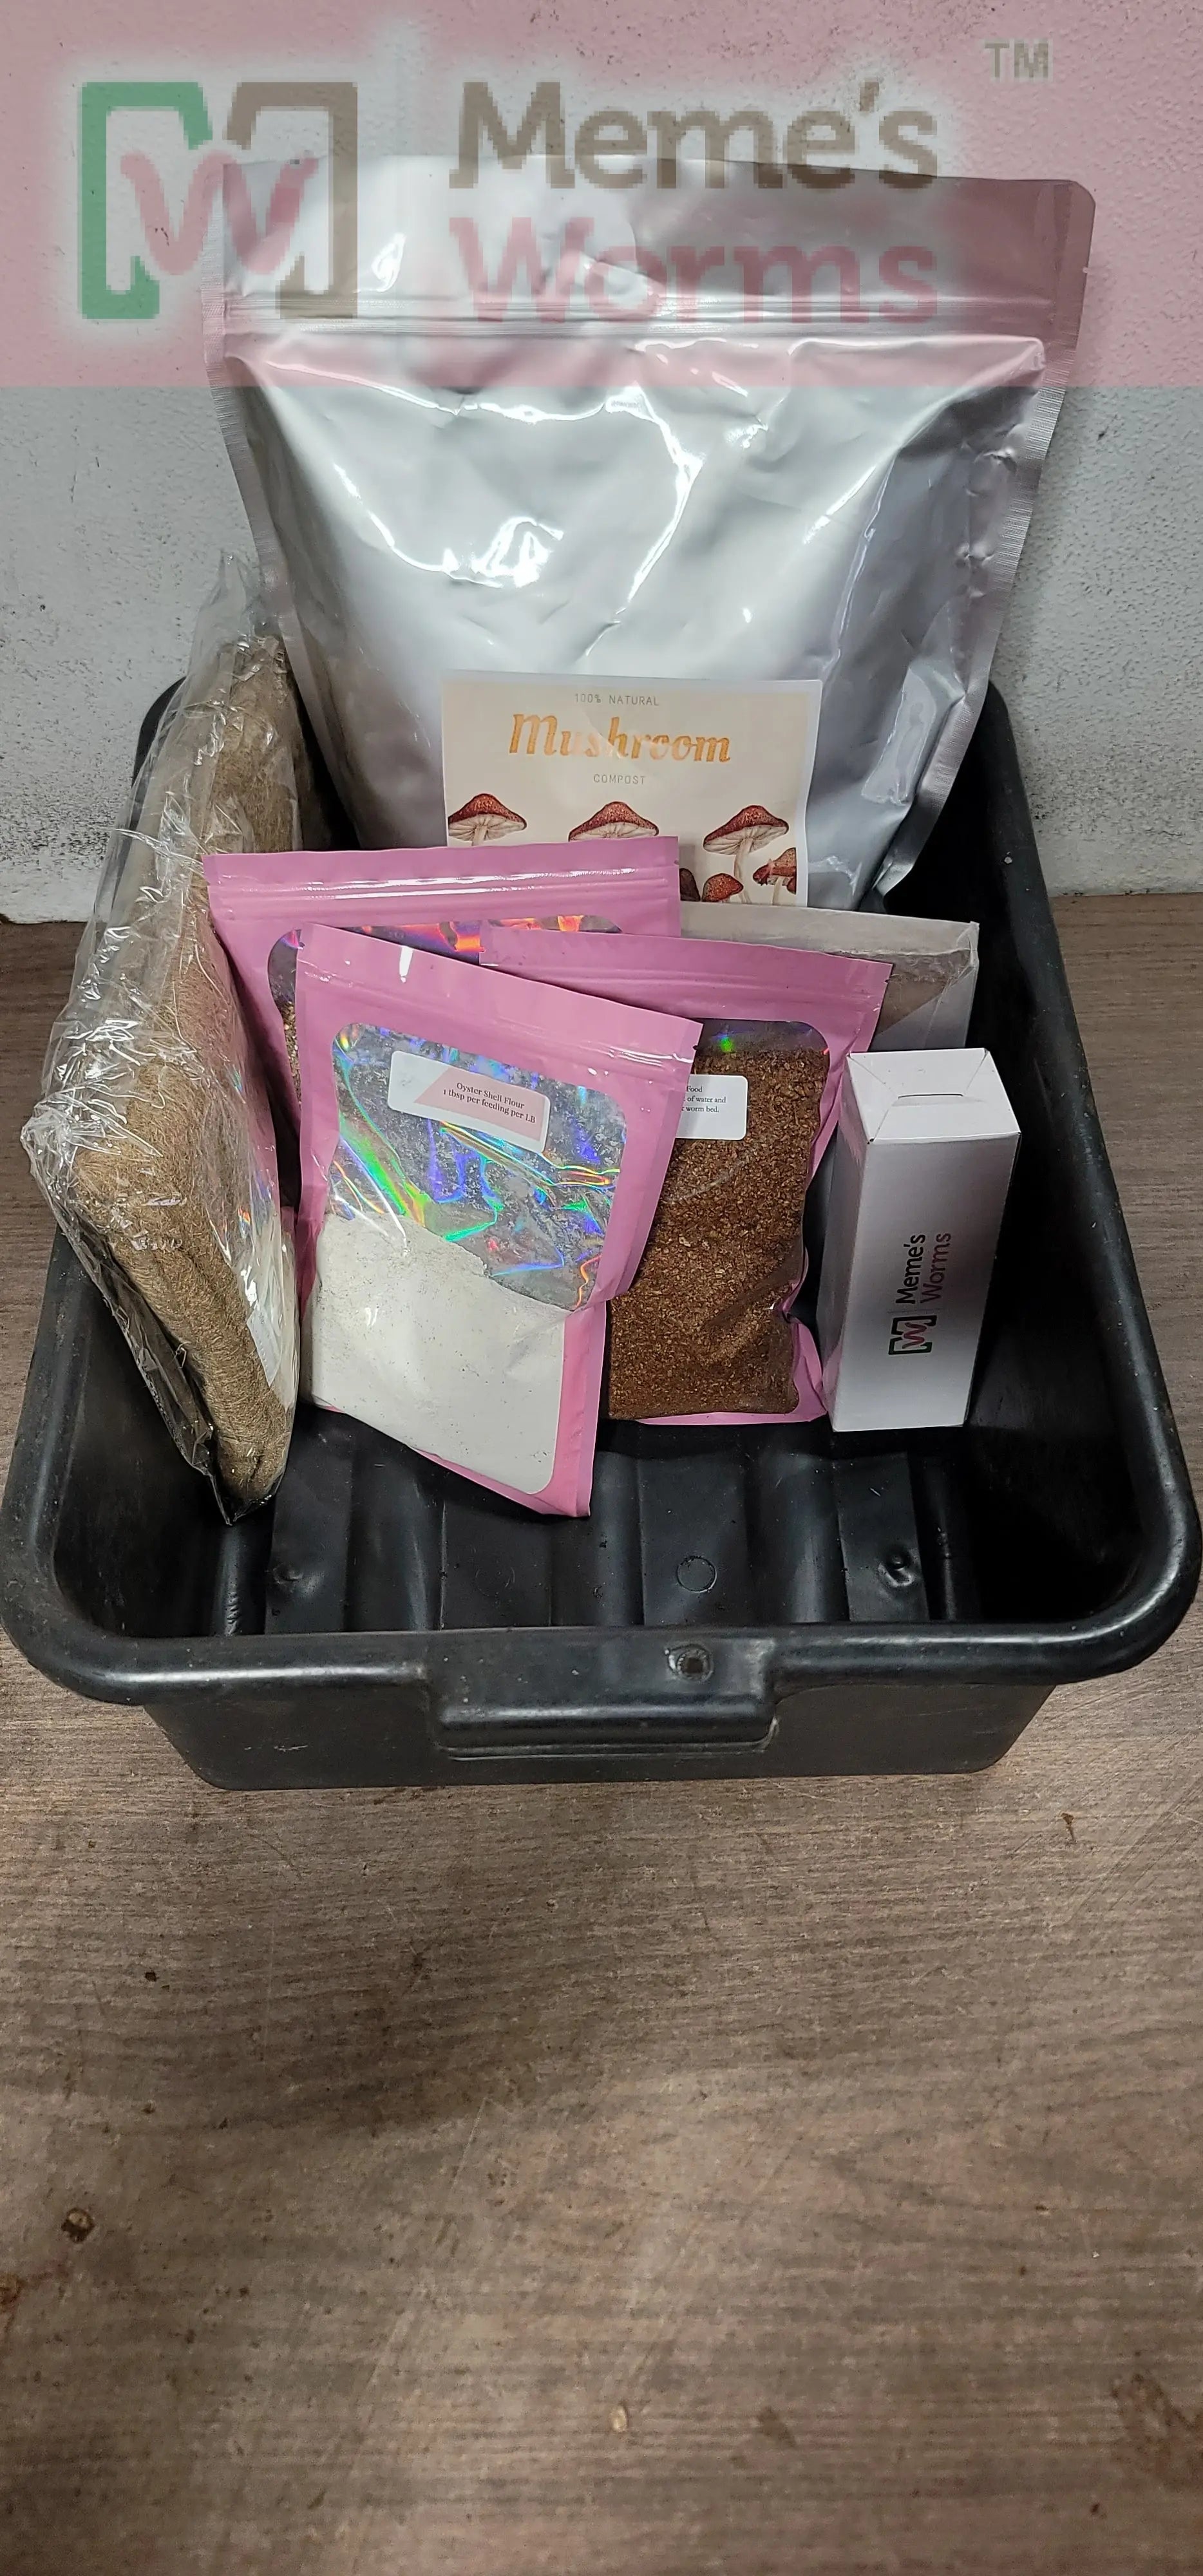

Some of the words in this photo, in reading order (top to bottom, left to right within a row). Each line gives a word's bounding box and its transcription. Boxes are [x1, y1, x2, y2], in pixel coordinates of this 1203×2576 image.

[574, 693, 602, 704] 100%
[609, 695, 659, 706] NATURAL
[509, 714, 731, 762] Mushroom
[593, 773, 647, 785] COMPOST
[448, 1089, 465, 1101] tbsp
[466, 1095, 480, 1104] per
[482, 1099, 509, 1115] feeding
[511, 1109, 524, 1119] per
[526, 1113, 536, 1123] LB
[457, 1082, 482, 1095] Oyster
[483, 1090, 502, 1102] Shell
[504, 1097, 525, 1109] Flour
[895, 1233, 926, 1305] Meme's
[920, 1232, 952, 1303] Worms
